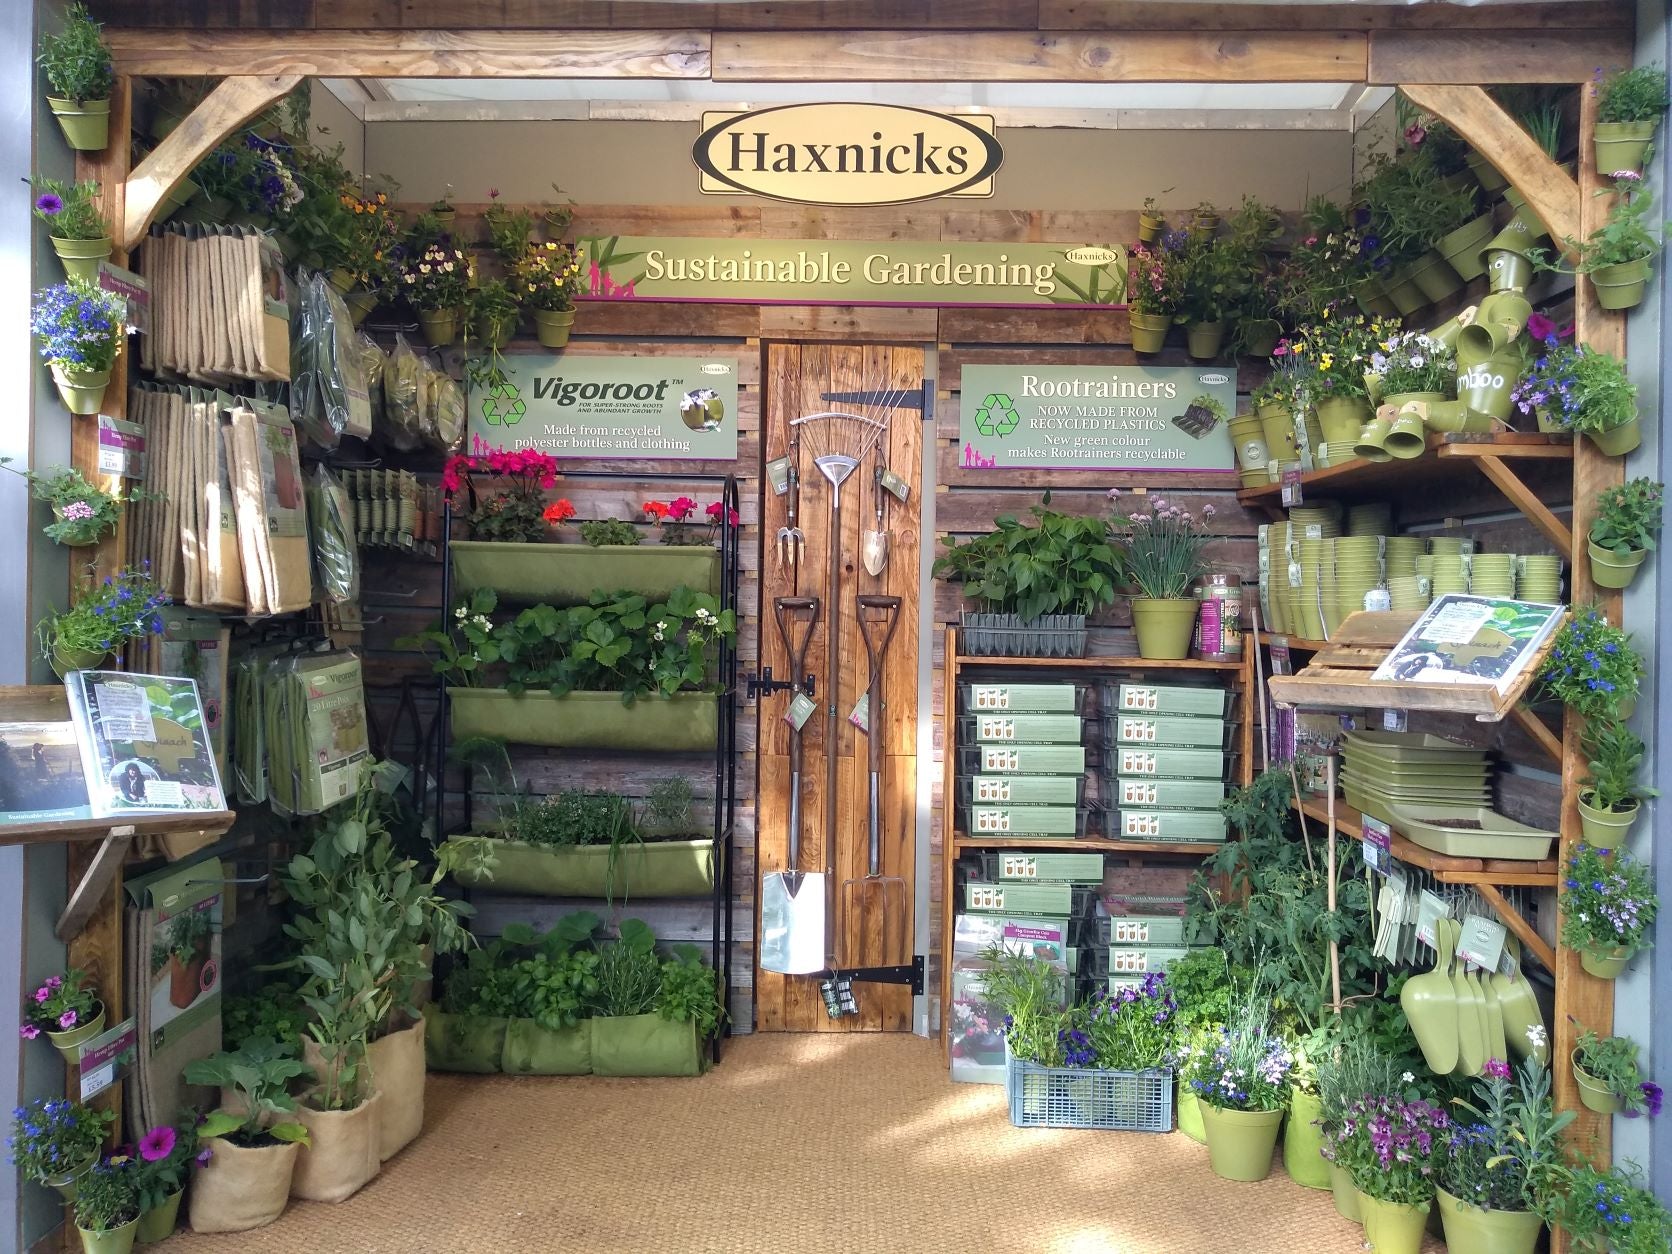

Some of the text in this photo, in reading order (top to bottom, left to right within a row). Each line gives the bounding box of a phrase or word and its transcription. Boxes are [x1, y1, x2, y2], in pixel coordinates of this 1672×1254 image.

[727, 131, 969, 176] Haxnicks
[1070, 250, 1115, 262] Haxnicks
[645, 249, 1056, 296] Sustainable Gardening
[532, 377, 669, 407] Vigoroot
[1020, 375, 1177, 399] Rootrainers
[1038, 405, 1158, 417] NOW MADE FROM
[543, 424, 661, 439] Made from recycled
[1030, 418, 1166, 430] RECYCLED PLASTICS
[514, 437, 690, 452] polyester bottles and clothing
[1044, 434, 1151, 447] New green colour
[1008, 446, 1186, 462] makes Rootrainers recyclable
